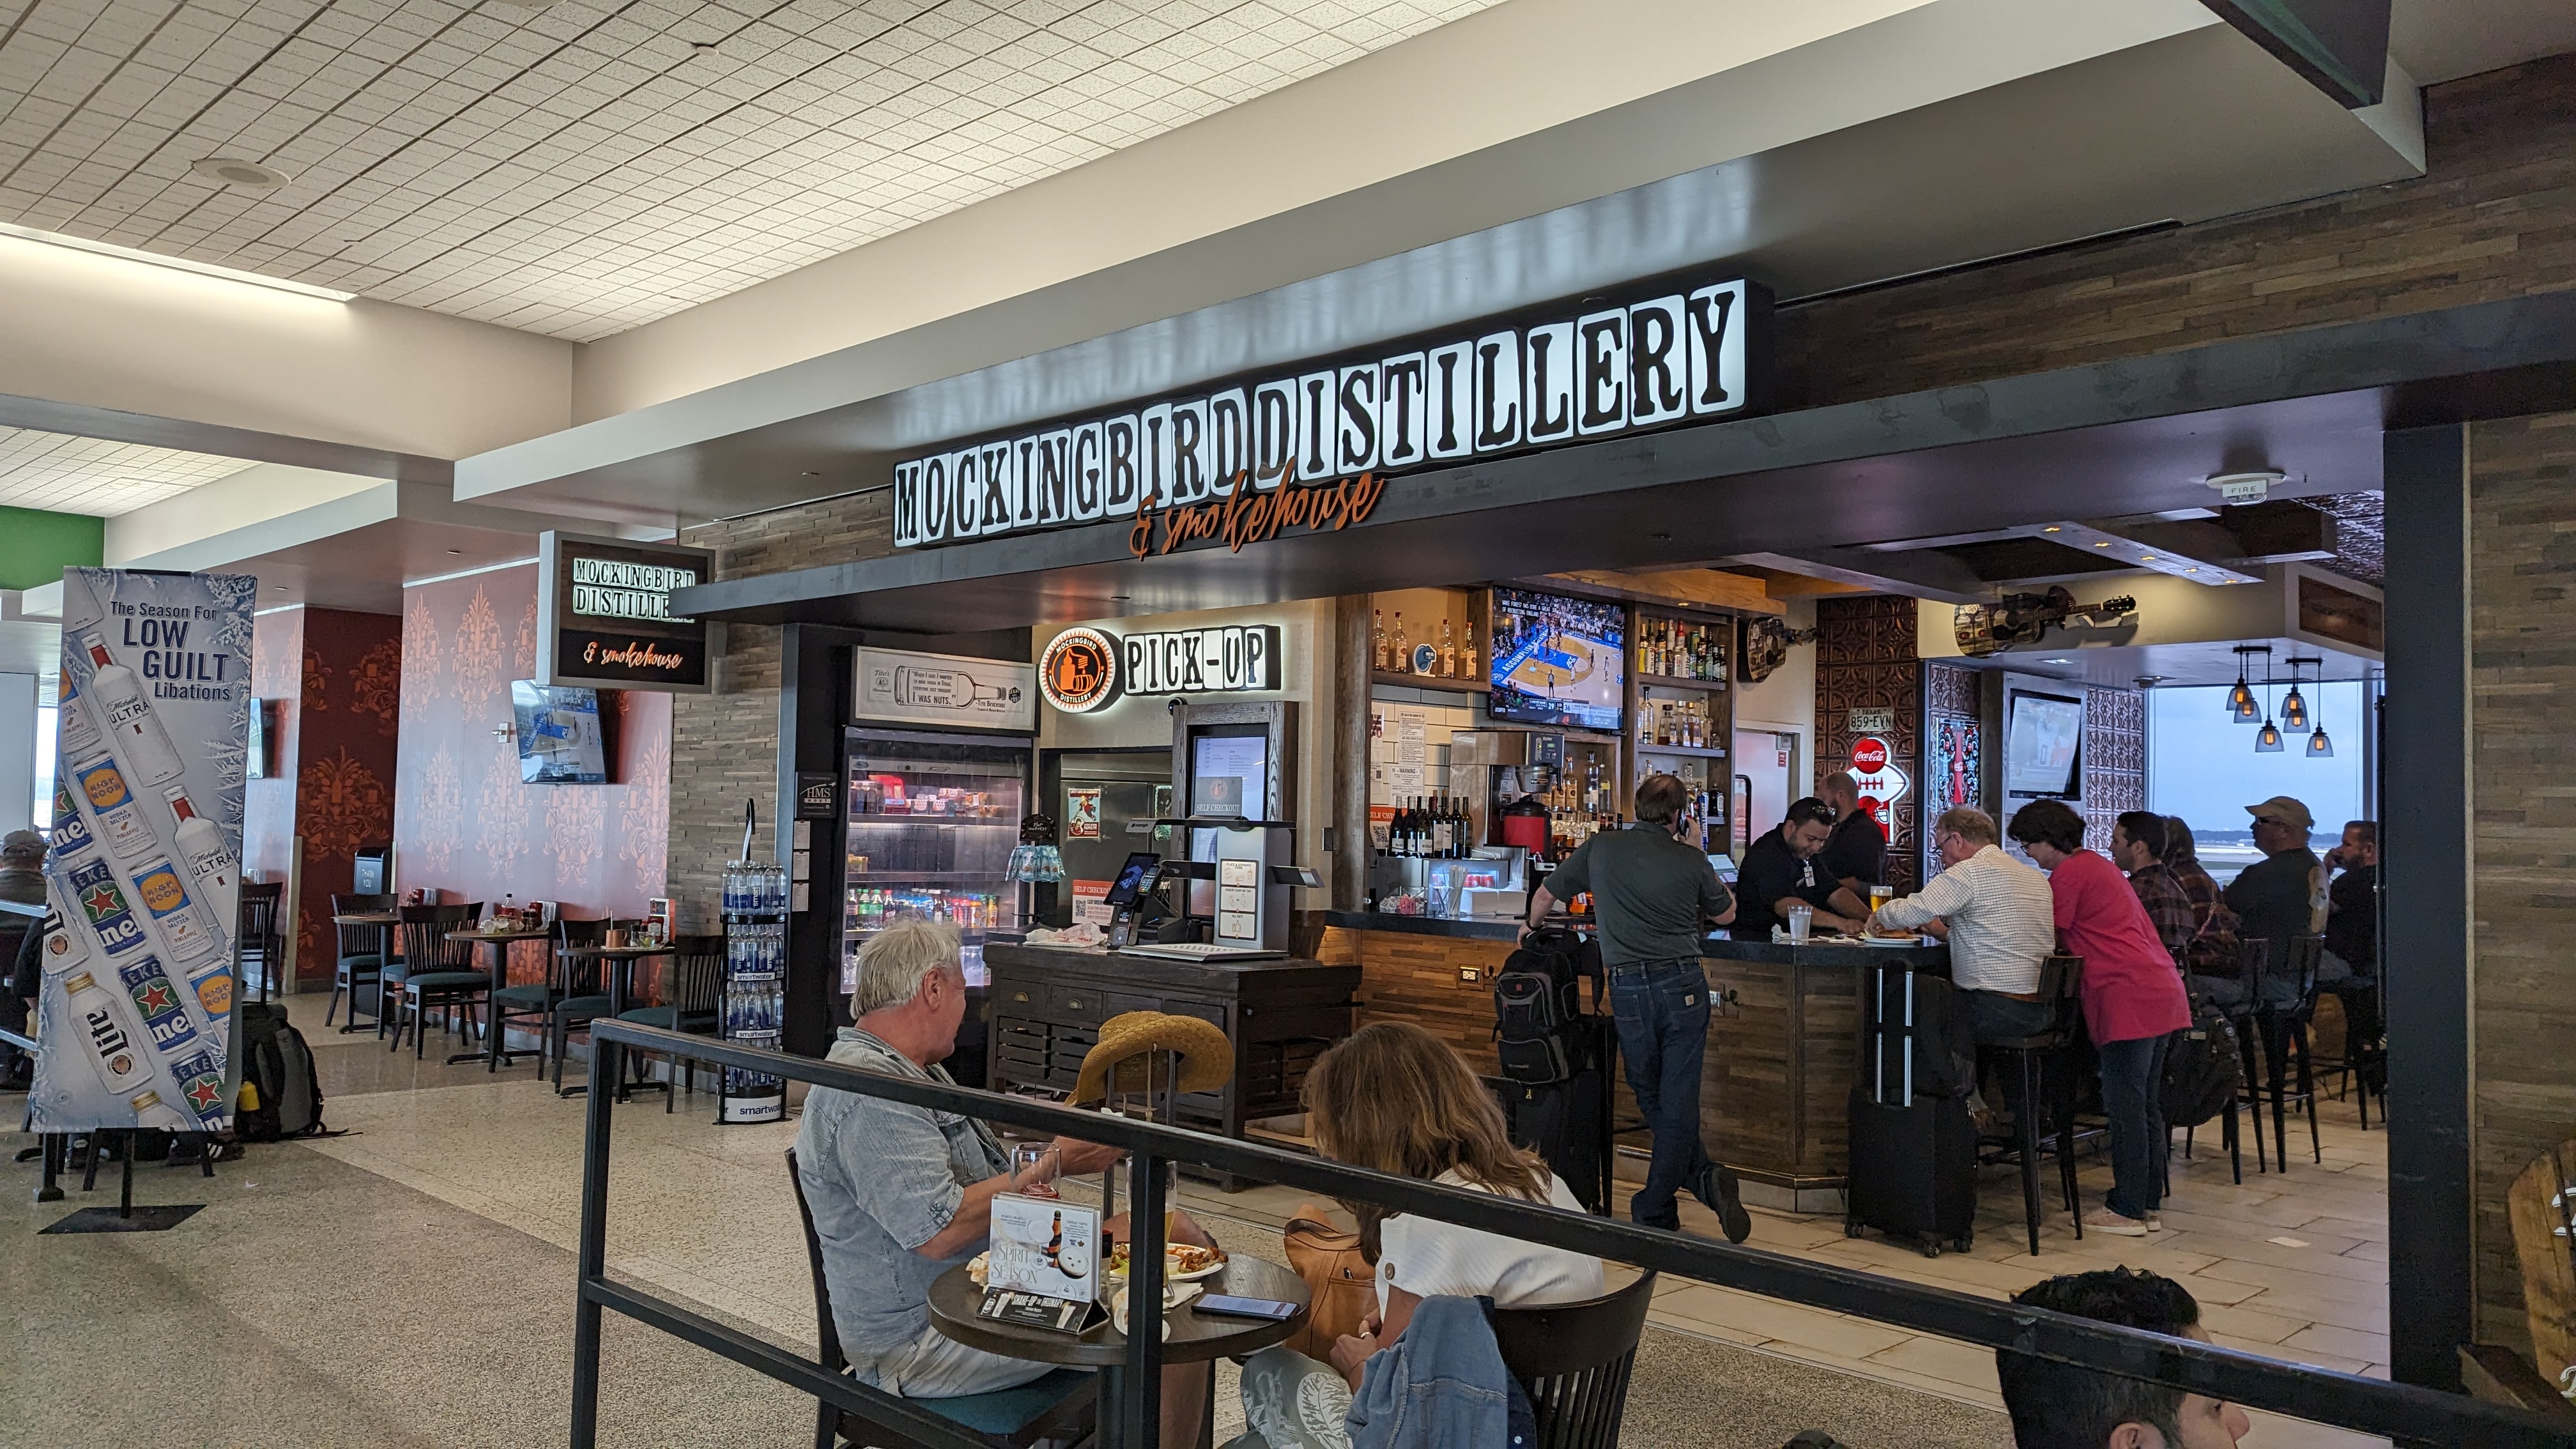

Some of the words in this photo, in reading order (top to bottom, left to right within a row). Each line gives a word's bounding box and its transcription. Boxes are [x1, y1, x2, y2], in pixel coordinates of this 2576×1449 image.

[896, 399, 1243, 540] MOCKINGBIRD
[1257, 291, 1736, 479] DISTILLERY
[2232, 486, 2256, 494] FIRE
[1130, 494, 1156, 562] &
[1162, 455, 1385, 553] smokehouse
[576, 560, 693, 590] MOCKINGBIRD
[111, 601, 134, 616] The
[139, 602, 190, 618] Season
[194, 606, 218, 620] For
[576, 588, 675, 619] DISTILLE
[123, 618, 190, 648] LOW
[583, 641, 598, 664] &
[601, 641, 683, 669] smokehouse
[1055, 637, 1097, 654] MOCKINGBIRD
[142, 650, 229, 682] GUILT
[1127, 632, 1264, 690] PICK-UP
[155, 682, 231, 701] Libations
[913, 691, 915, 702] I
[918, 694, 931, 703] WAS
[1059, 692, 1091, 702] DISTILLERY
[109, 700, 151, 724] ULTRA
[807, 787, 831, 798] HMS
[192, 852, 233, 876] ULTRA
[86, 1007, 130, 1061] Lite
[739, 1103, 781, 1116] smartwat
[997, 1245, 1031, 1264] SPIRIT
